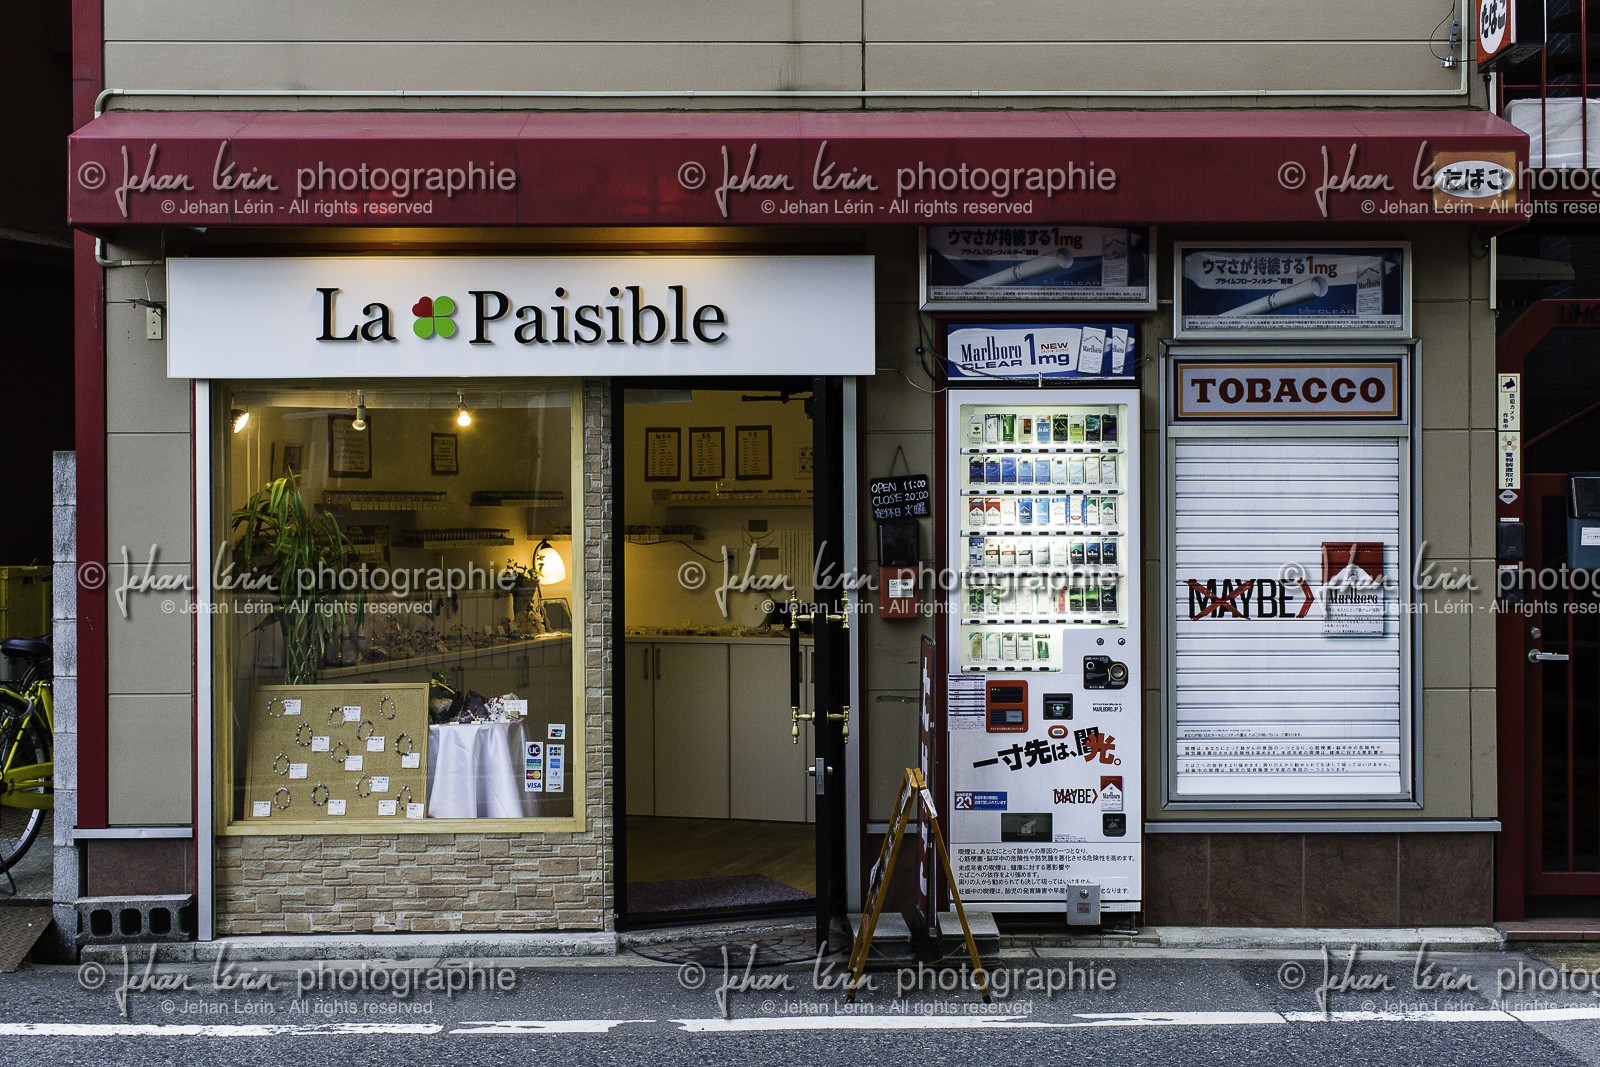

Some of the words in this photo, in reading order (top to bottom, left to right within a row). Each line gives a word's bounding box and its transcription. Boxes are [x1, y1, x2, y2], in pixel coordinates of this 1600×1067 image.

[1442, 168, 1505, 190] たばこ
[316, 287, 395, 342] La
[469, 285, 728, 345] Paisible
[961, 336, 1022, 363] Marlboro
[1024, 333, 1070, 366] 1mg
[1040, 342, 1068, 350] NEW
[962, 360, 1023, 370] CLEAR
[1191, 377, 1386, 404] TOBACCO
[871, 482, 897, 494] OPEN
[903, 479, 926, 491] 11:00
[872, 493, 903, 506] CLOSE
[905, 490, 929, 502] 20:00
[1188, 578, 1295, 619] MAYBE
[1328, 582, 1378, 604] Marlboro
[956, 796, 973, 809] 20
[1053, 788, 1091, 804] MAYBE
